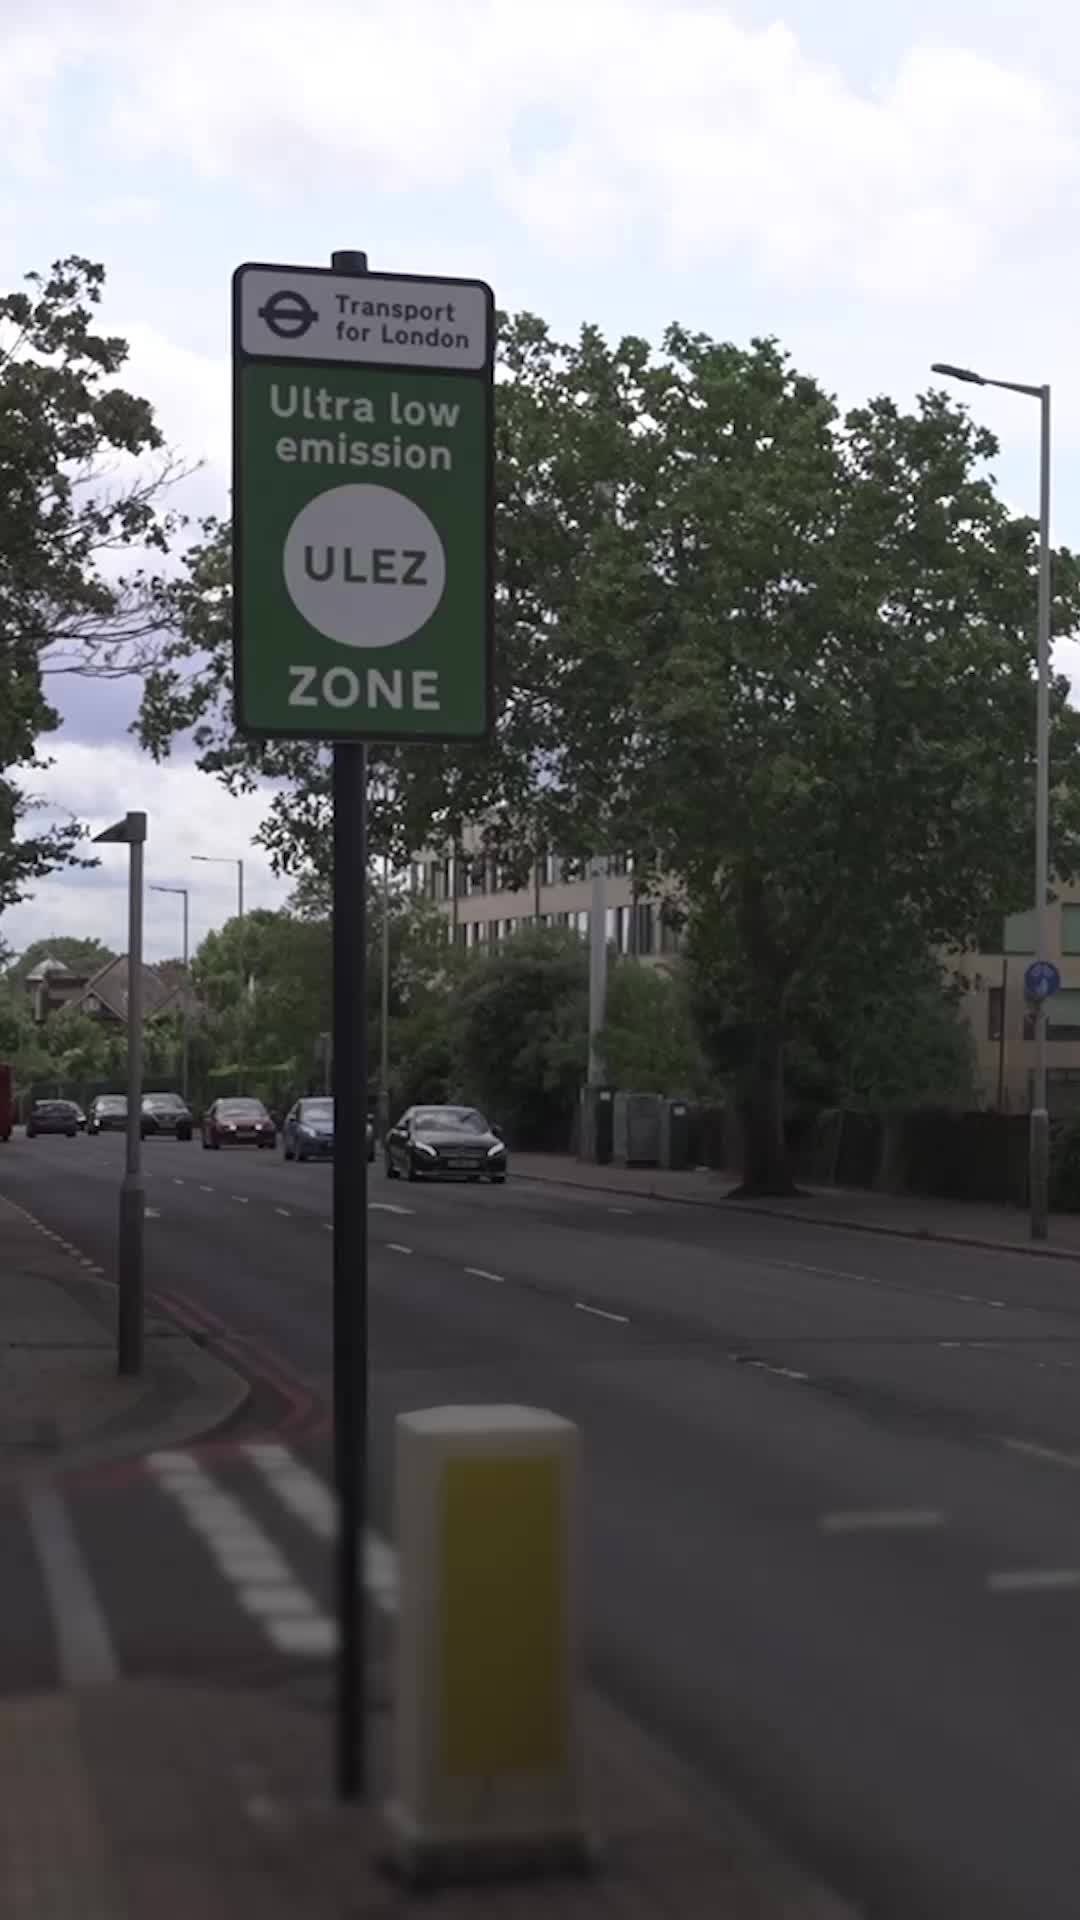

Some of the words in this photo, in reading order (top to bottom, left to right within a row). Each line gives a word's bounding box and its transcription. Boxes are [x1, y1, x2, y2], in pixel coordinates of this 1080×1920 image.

[335, 294, 455, 323] Transport
[335, 320, 371, 342] for
[381, 323, 469, 349] London
[270, 384, 375, 423] Ultra
[391, 391, 460, 428] low
[275, 431, 452, 471] emission
[304, 545, 428, 586] ULEZ
[288, 665, 441, 710] ZONE
